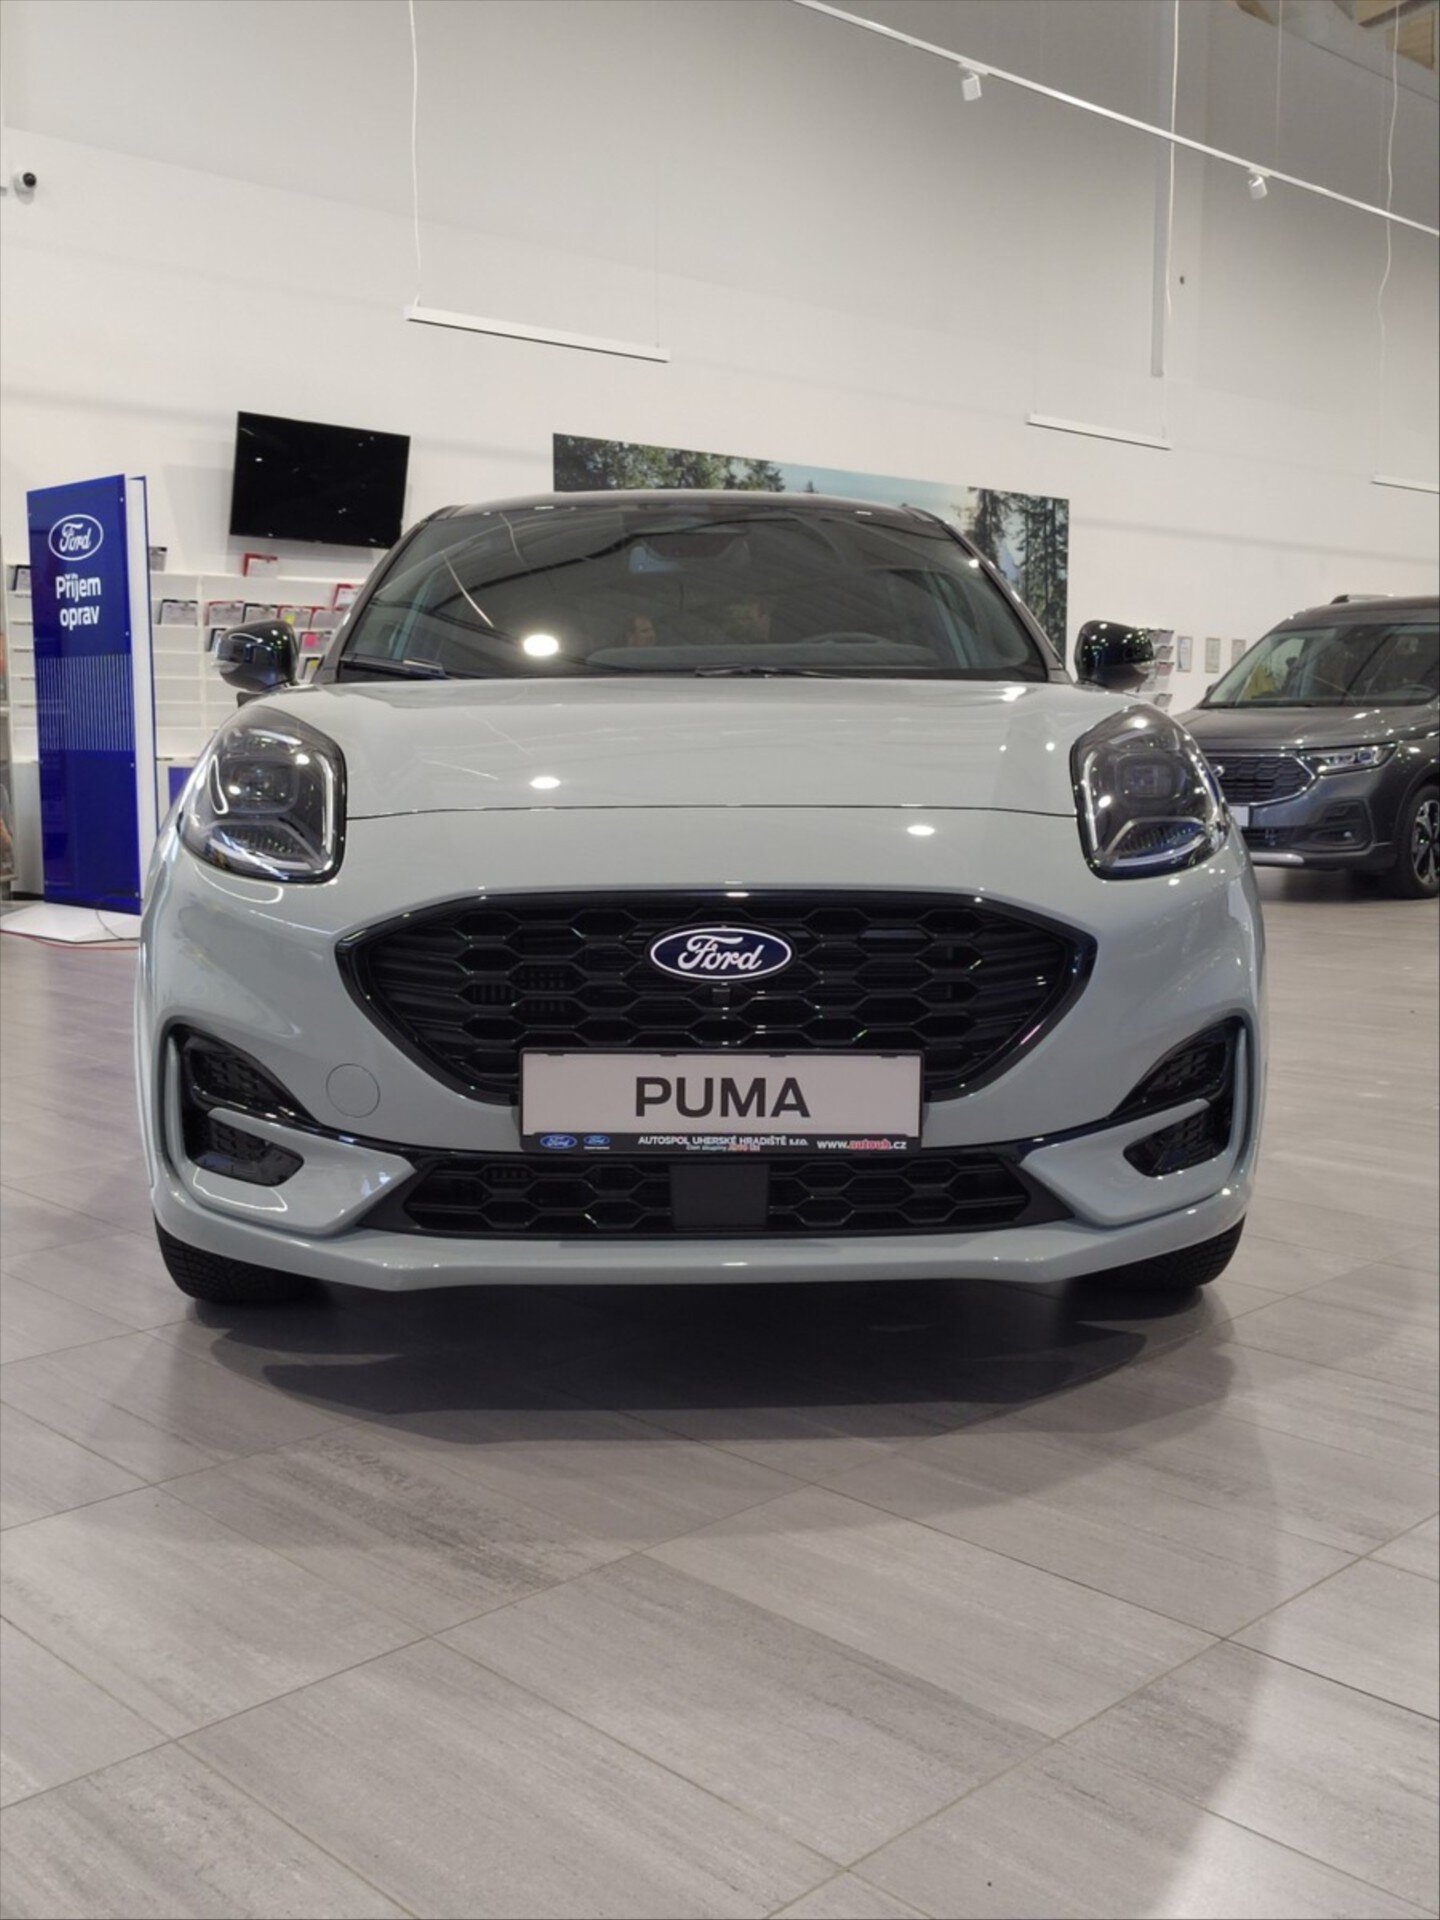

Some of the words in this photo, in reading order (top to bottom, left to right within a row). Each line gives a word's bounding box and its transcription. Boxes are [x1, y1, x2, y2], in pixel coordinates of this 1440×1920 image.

[60, 523, 91, 552] Ford
[55, 573, 101, 602] Příjem
[60, 606, 100, 631] oprav
[678, 935, 765, 970] Ford
[636, 1076, 811, 1118] PUMA
[637, 1136, 689, 1146] AUTOSPOL
